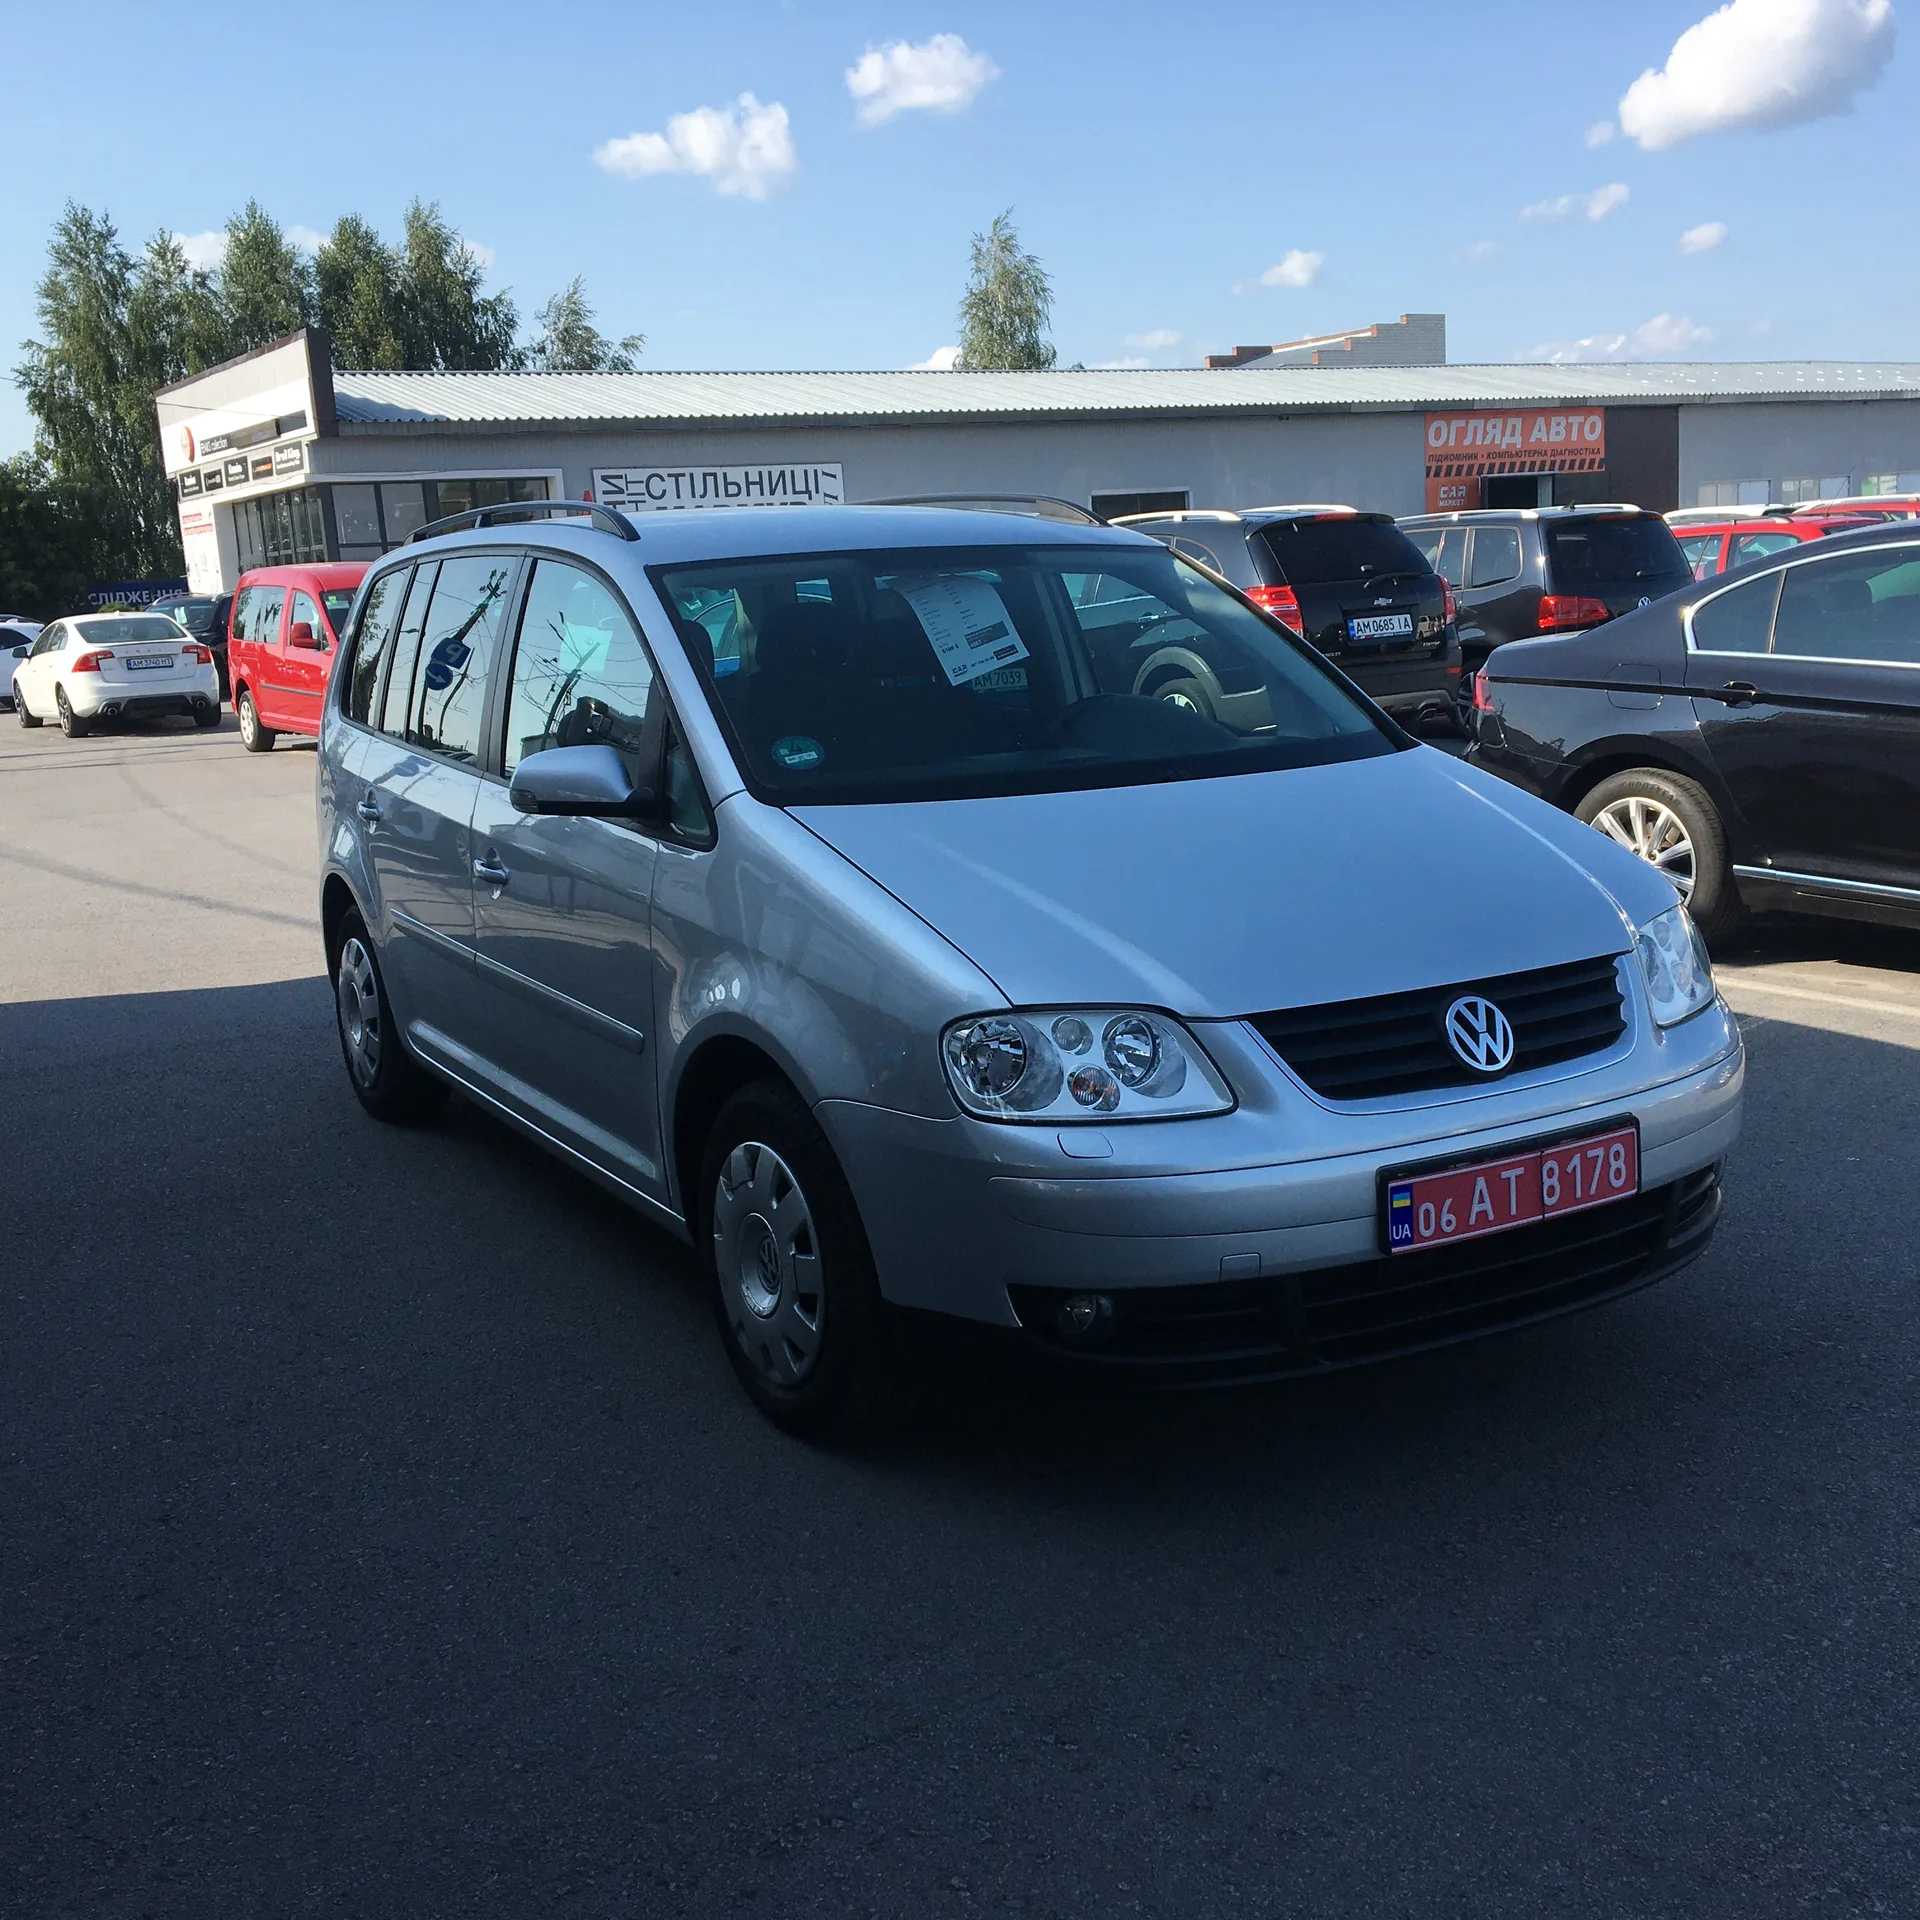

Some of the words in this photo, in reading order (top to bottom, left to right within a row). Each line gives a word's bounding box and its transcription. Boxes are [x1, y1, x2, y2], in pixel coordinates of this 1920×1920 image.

[1428, 419, 1523, 449] ОГЛЯД
[1529, 415, 1602, 442] АВТО
[645, 469, 820, 500] СТІЛЬНИЦІ
[1439, 484, 1467, 498] CAR
[1438, 498, 1465, 507] MARKET
[1356, 621, 1371, 635] AM
[1372, 618, 1395, 632] 0685
[1397, 617, 1411, 629] IA
[132, 660, 143, 668] AM
[161, 658, 172, 666] HT
[952, 664, 968, 674] CAR
[974, 673, 993, 688] AM
[993, 671, 1021, 686] 7039
[1417, 1198, 1457, 1238] 06
[1468, 1167, 1525, 1226] AT
[1541, 1142, 1627, 1207] 8178
[1392, 1223, 1412, 1240] UA
